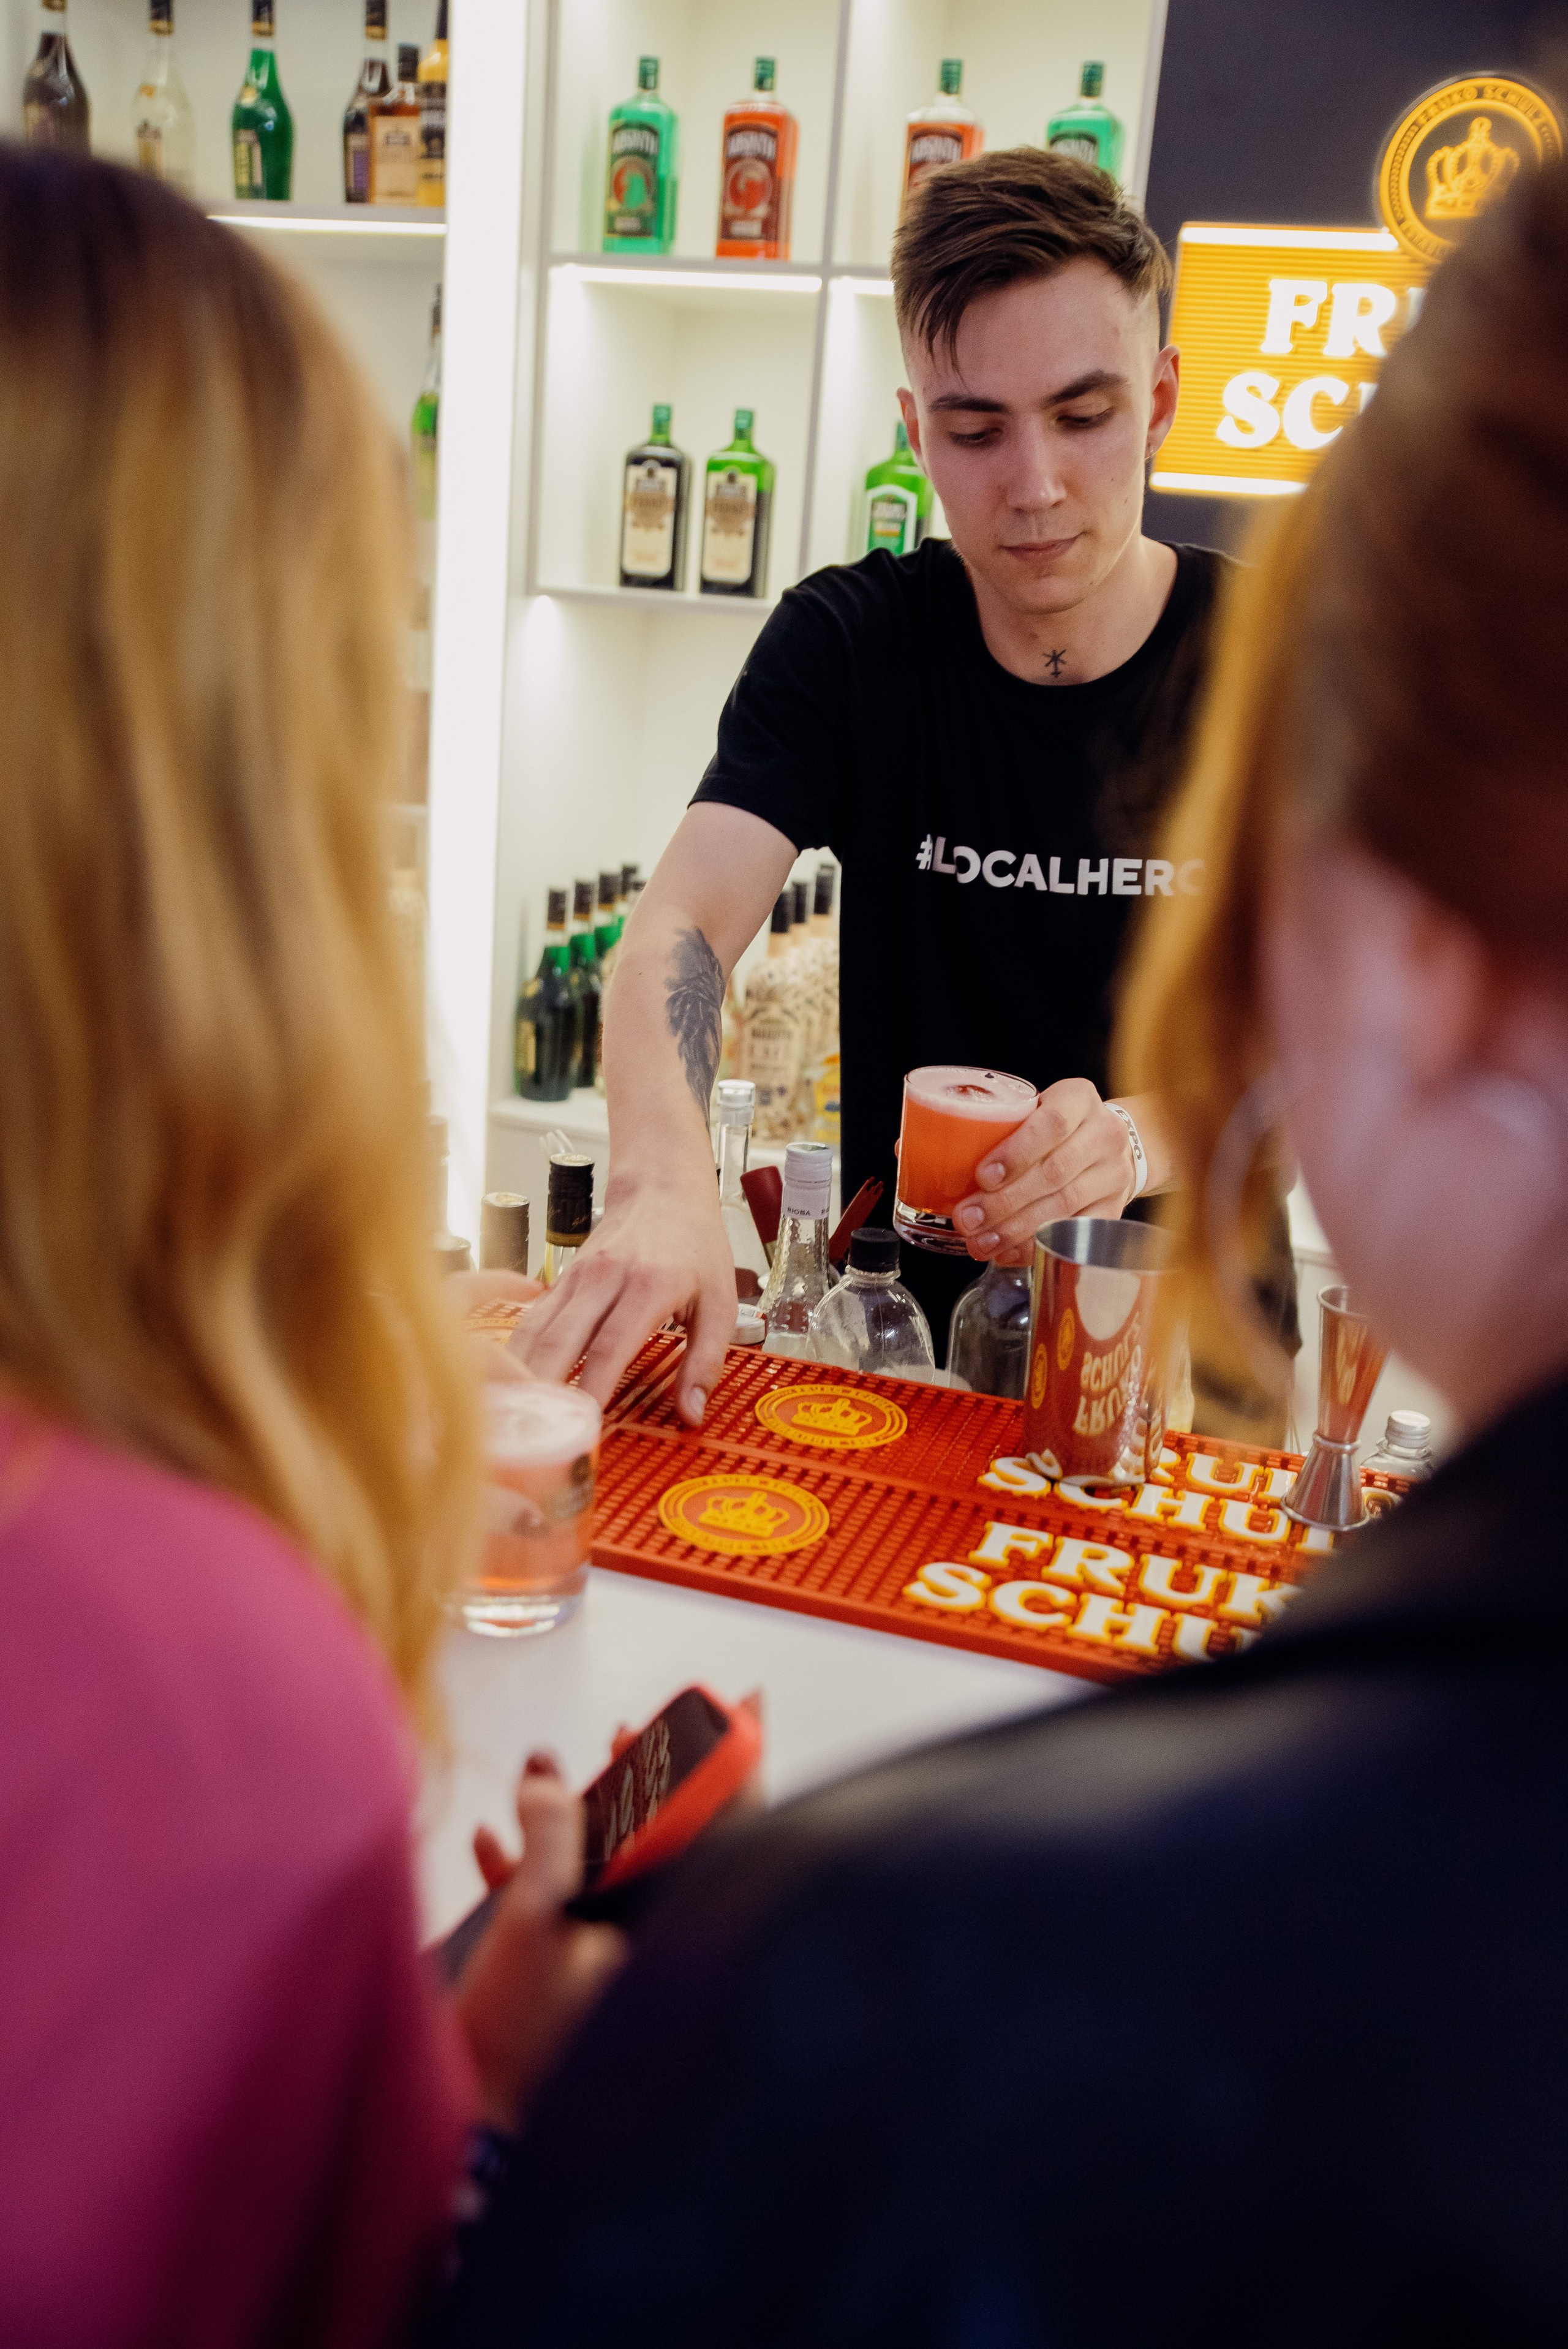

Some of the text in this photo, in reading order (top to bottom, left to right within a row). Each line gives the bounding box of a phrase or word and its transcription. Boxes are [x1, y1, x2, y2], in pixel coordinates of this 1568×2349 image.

[1216, 371, 1378, 450] SC
[1115, 1109, 1142, 1160] EXPO
[787, 1207, 811, 1216] RIOBA
